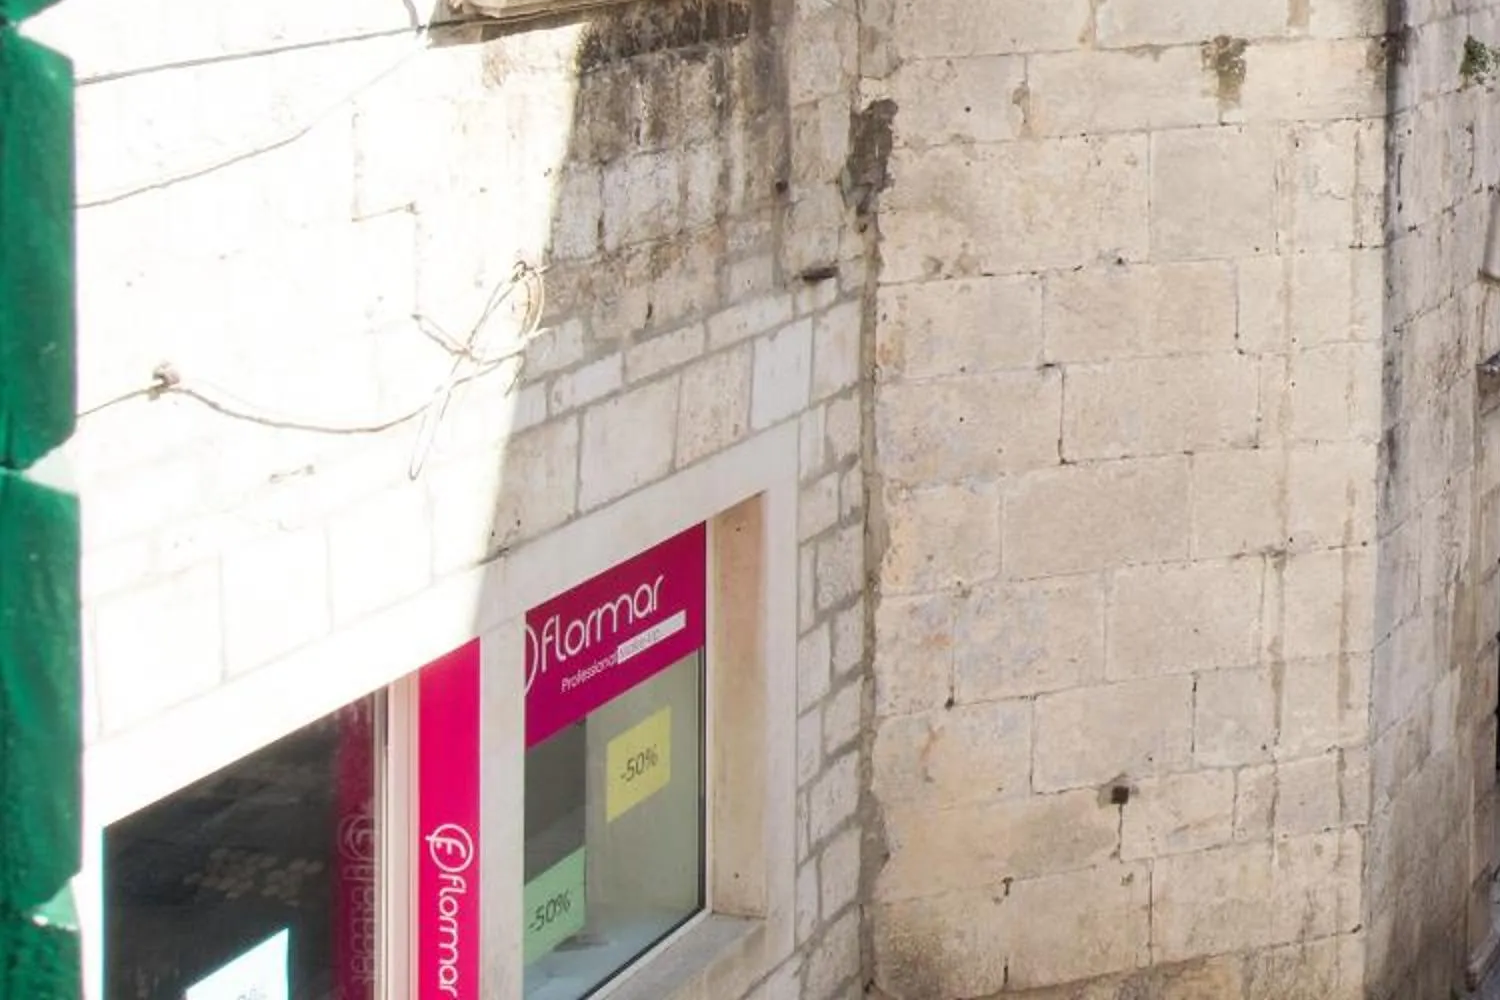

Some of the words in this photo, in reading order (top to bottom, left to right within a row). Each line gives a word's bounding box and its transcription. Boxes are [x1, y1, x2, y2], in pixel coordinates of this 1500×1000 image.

[541, 574, 664, 673] flormar
[620, 744, 659, 783] -50%
[437, 873, 467, 998] flormar
[529, 889, 572, 931] -50%
